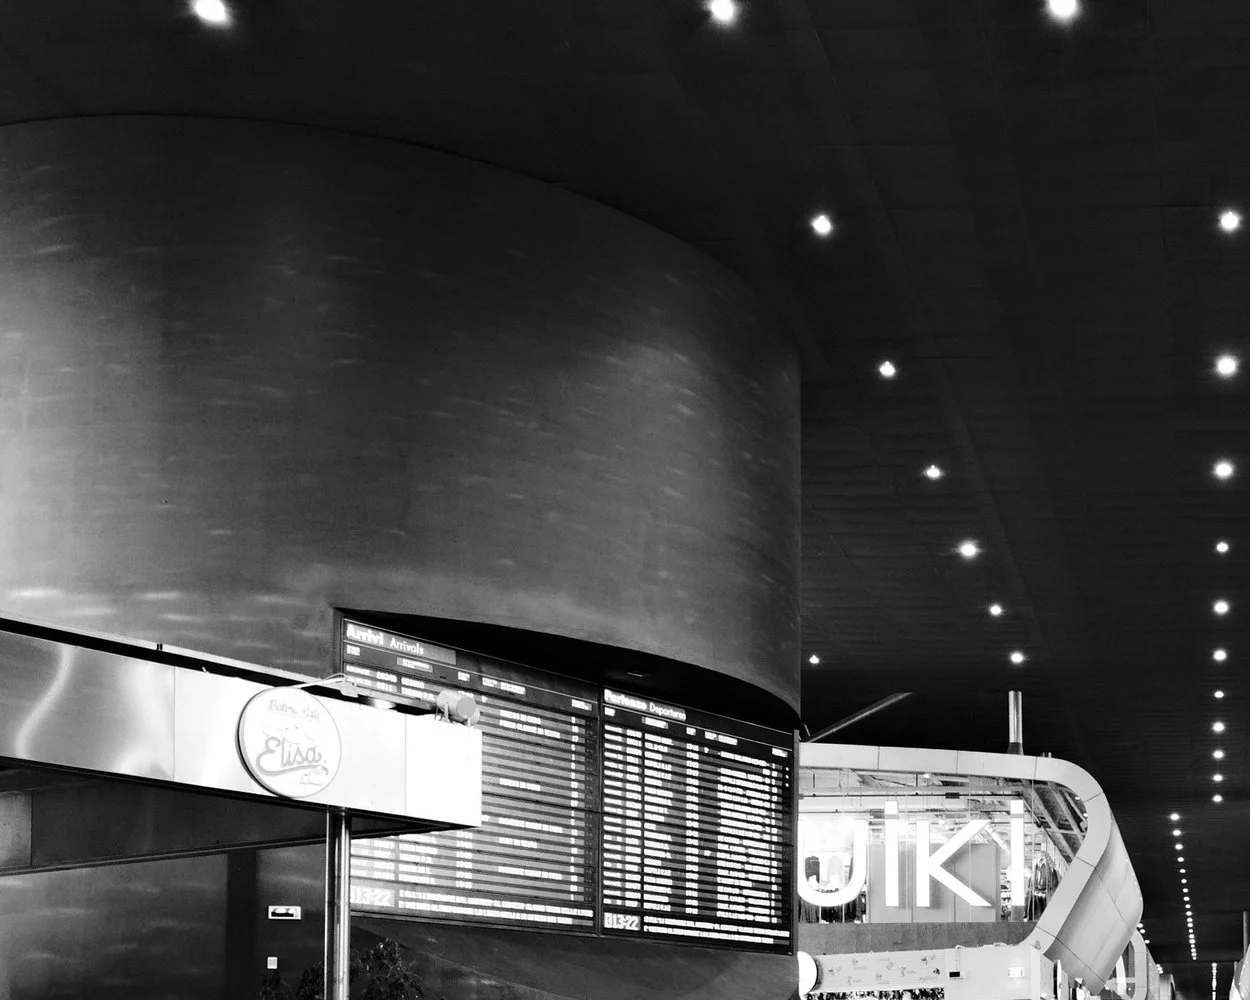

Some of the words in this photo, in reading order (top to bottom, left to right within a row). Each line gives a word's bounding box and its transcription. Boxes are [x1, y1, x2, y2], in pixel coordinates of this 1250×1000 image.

[346, 623, 384, 645] Arrivi
[389, 637, 424, 655] Arrivals
[650, 702, 686, 720] Departures
